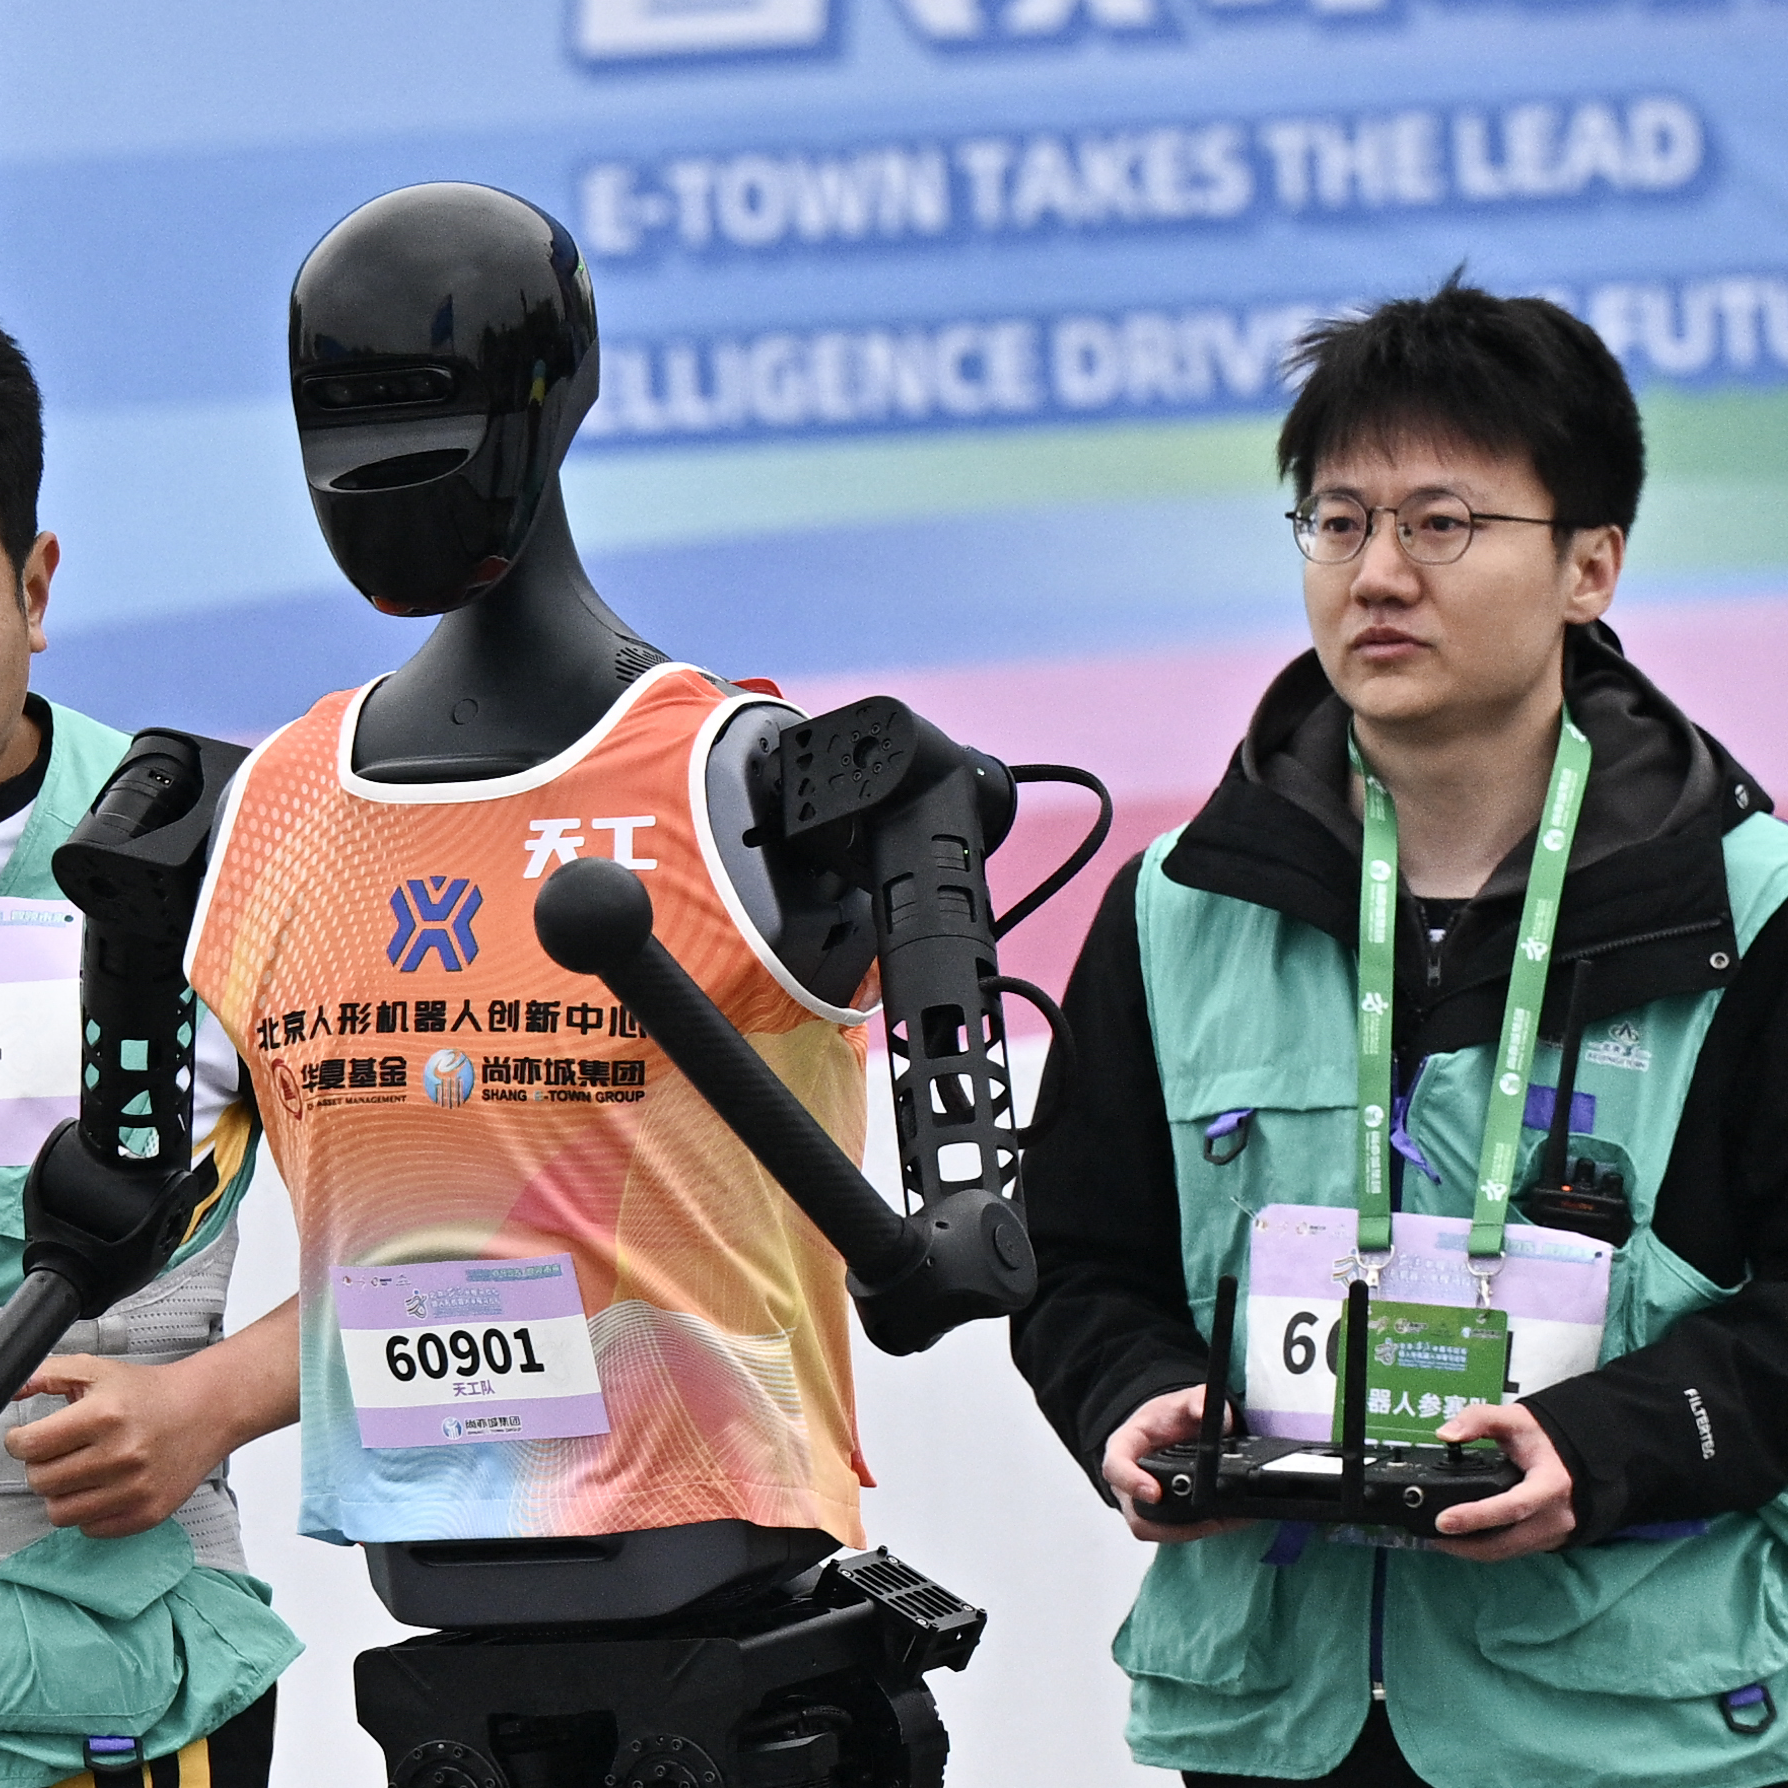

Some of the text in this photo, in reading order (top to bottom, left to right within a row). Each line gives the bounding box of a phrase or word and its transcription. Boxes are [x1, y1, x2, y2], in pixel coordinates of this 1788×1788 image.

[585, 92, 1705, 258] E-TOWN TAKES THE LEAD
[524, 815, 657, 880] 天工
[258, 999, 647, 1051] 北京人形机器人创新中心
[301, 1056, 407, 1093] 华夏基金
[482, 1056, 646, 1087] 尚亦城集团
[345, 1094, 407, 1105] MANAGEMENT
[482, 1089, 527, 1102] SHANG
[596, 1089, 646, 1103] GROUP
[386, 1328, 544, 1381] 60901
[453, 1380, 496, 1397] 天工队
[1367, 1388, 1488, 1420] 器人参赛
